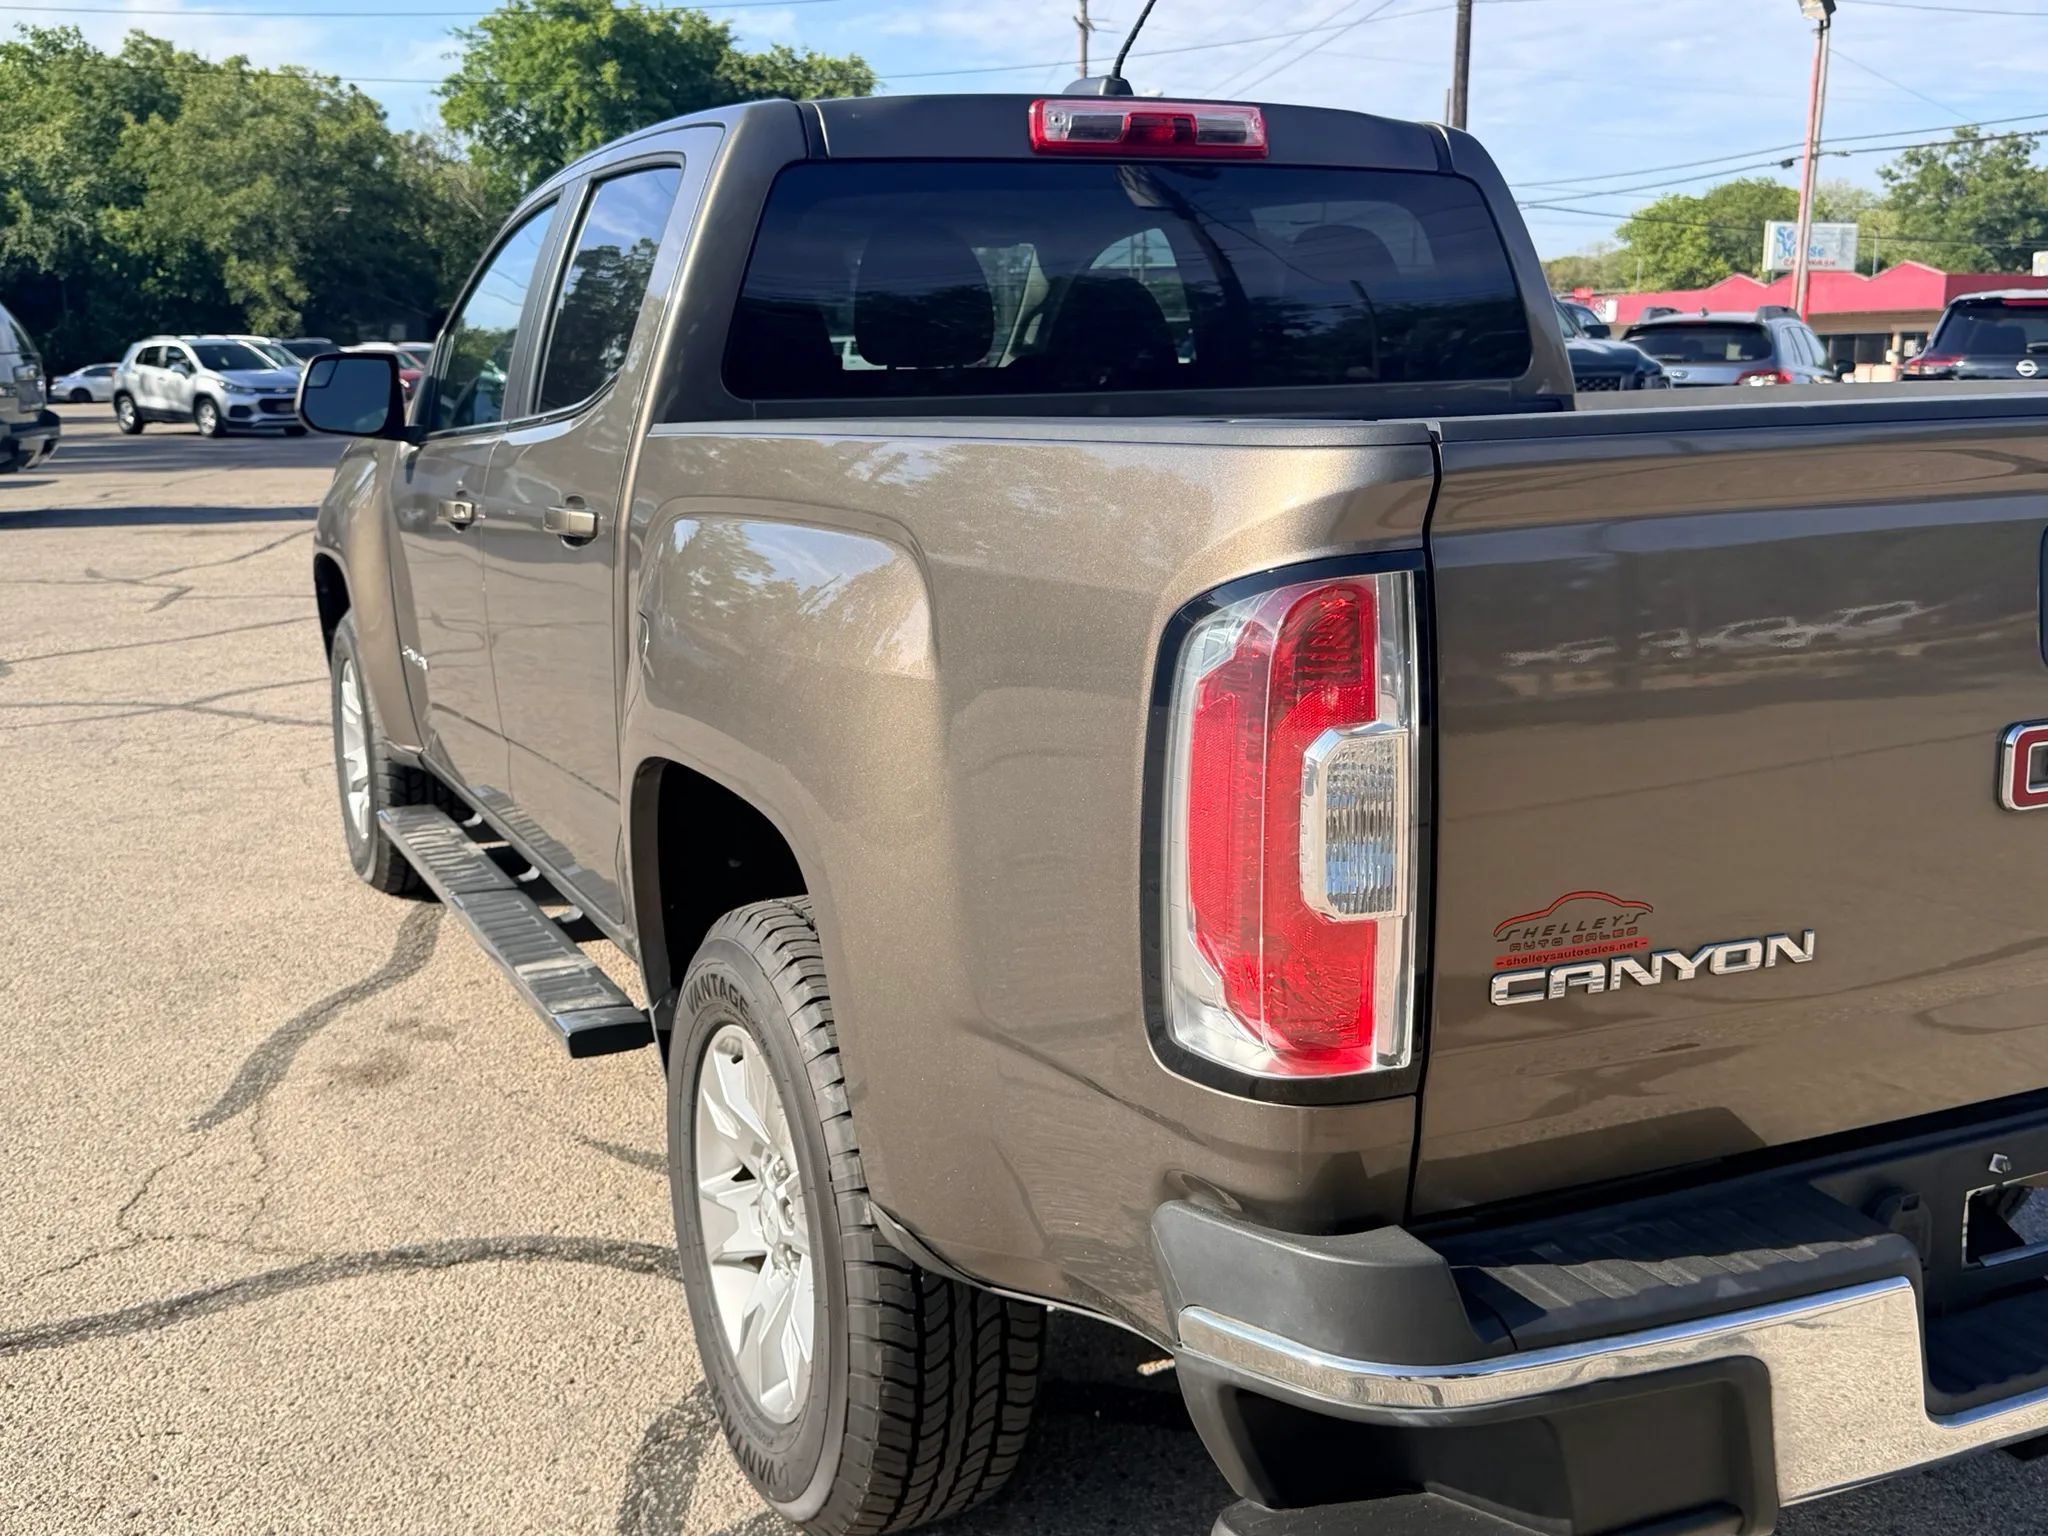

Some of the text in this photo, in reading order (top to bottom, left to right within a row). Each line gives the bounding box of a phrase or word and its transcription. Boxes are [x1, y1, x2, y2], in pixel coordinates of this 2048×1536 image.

[1496, 911, 1647, 943] SHELLEY'S
[1505, 940, 1639, 967] shelleysautosales.net
[1509, 936, 1564, 953] AUTO
[1490, 927, 1816, 1007] CANYON
[685, 972, 750, 1022] VANTAGE
